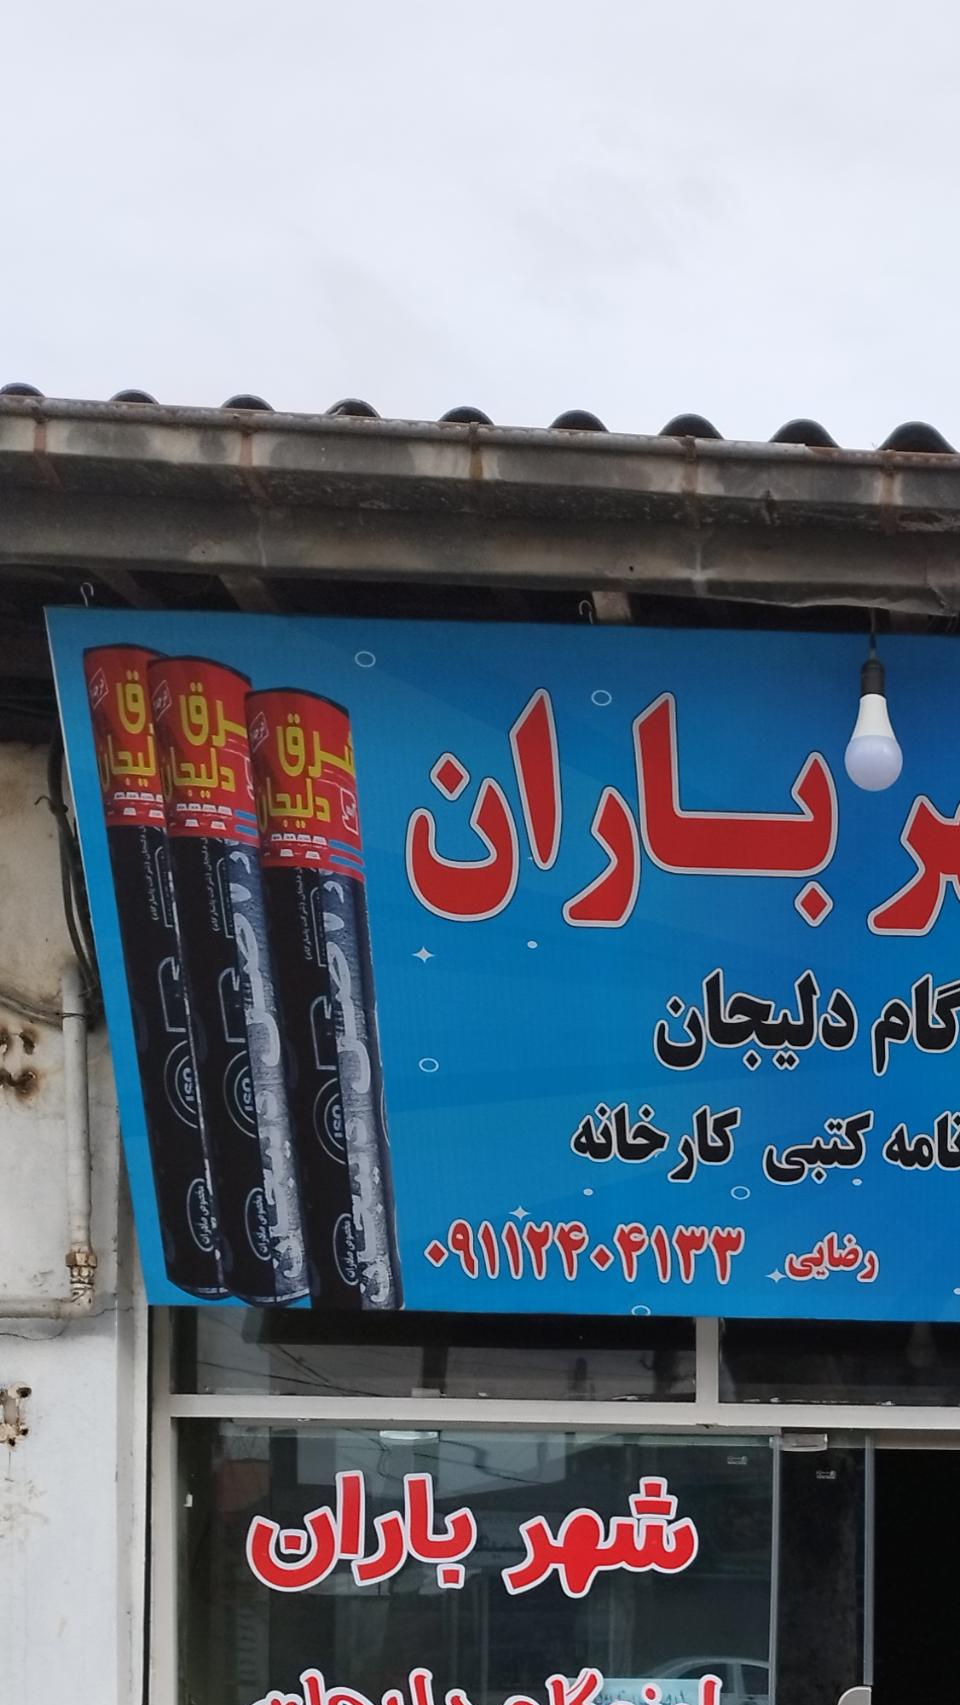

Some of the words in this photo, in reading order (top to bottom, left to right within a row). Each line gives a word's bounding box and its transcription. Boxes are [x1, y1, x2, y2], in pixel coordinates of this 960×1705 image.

[405, 687, 838, 929] باران
[653, 967, 857, 1070] دلیجان
[571, 1102, 741, 1183] کارخانه
[762, 1110, 874, 1184] کتبی
[424, 1219, 745, 1284] ۰۹۱۱۲۴۰۴۱۳۳
[785, 1233, 879, 1282] رضایی
[246, 1470, 477, 1592] باران
[502, 1476, 698, 1598] شهر
